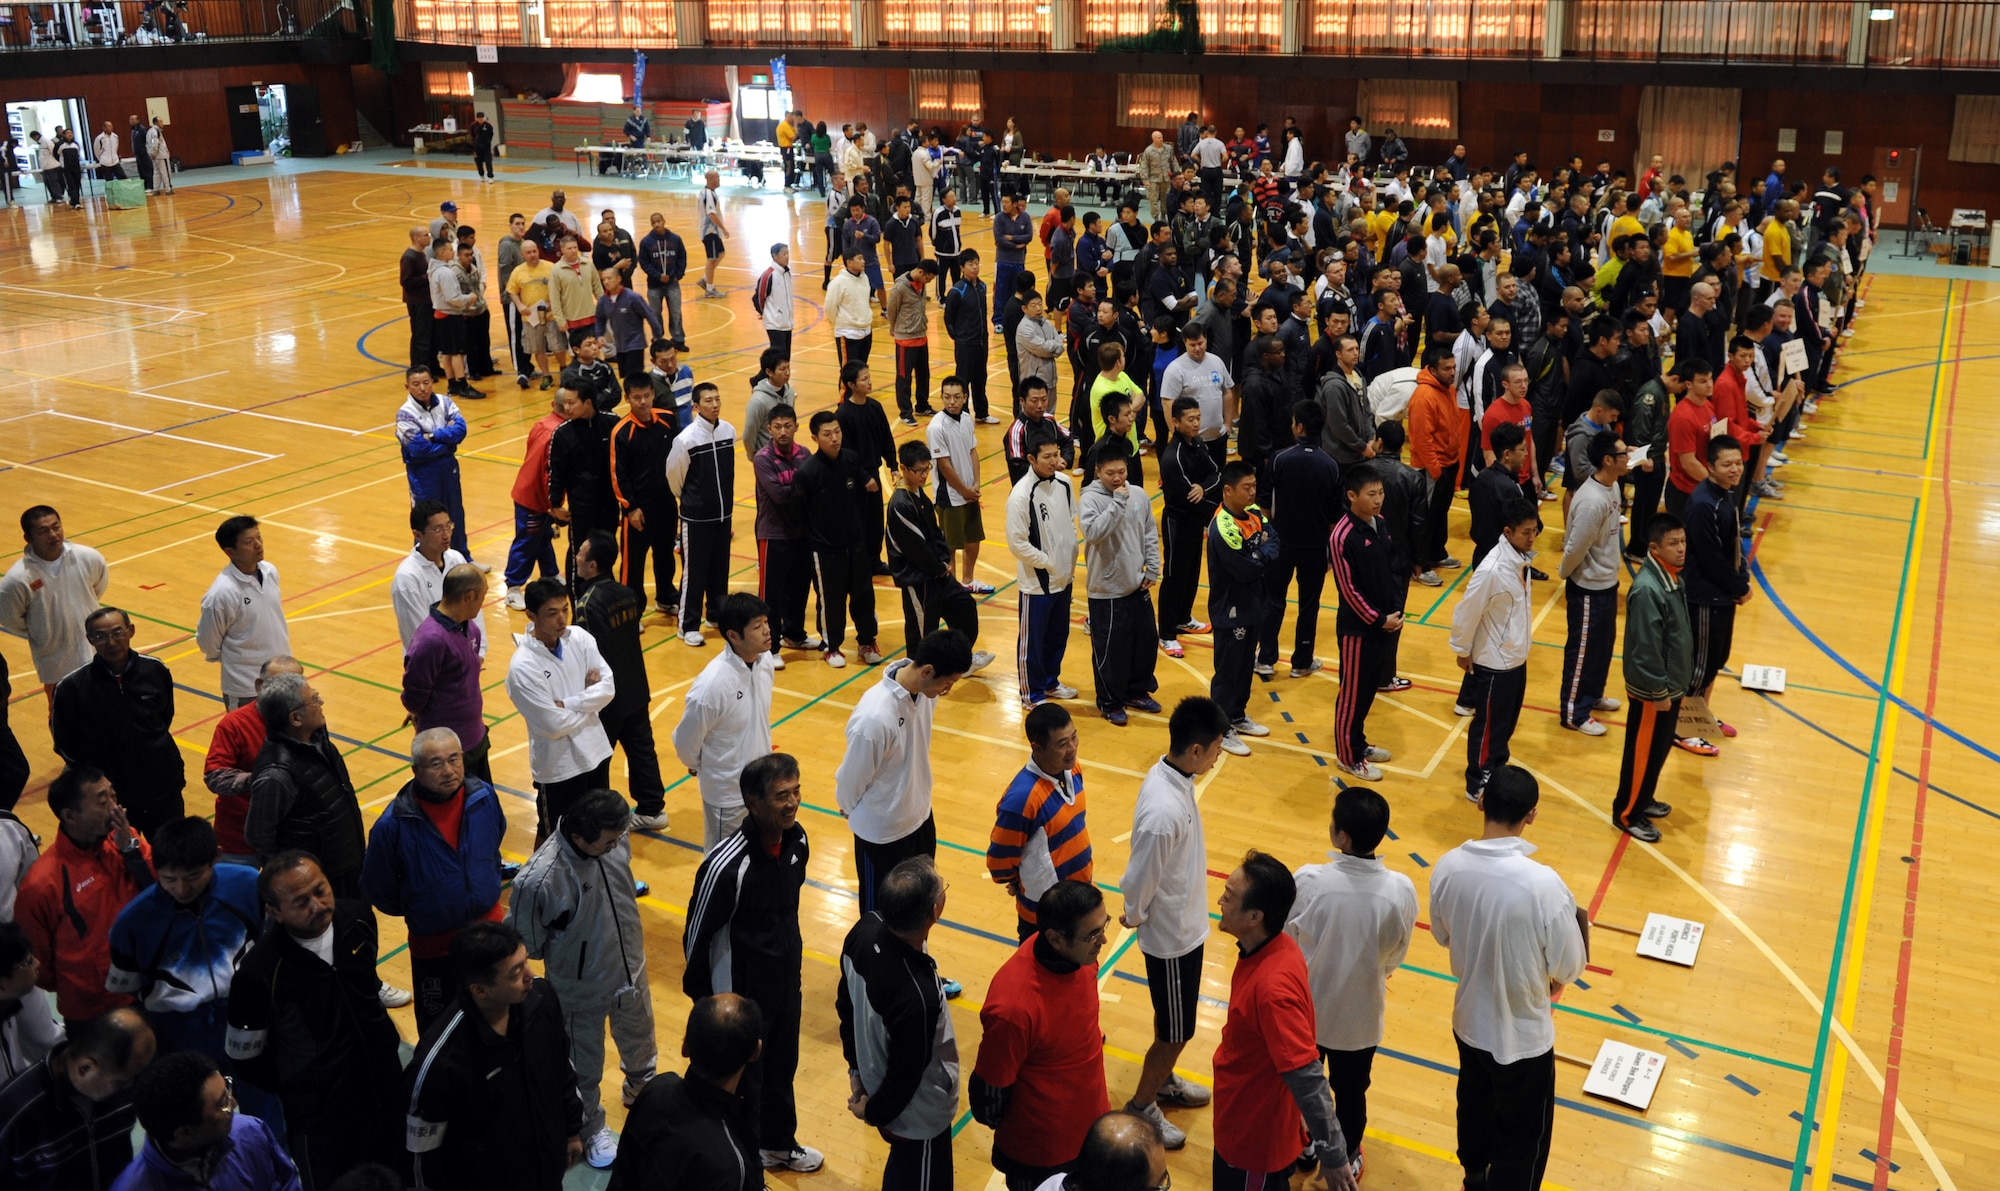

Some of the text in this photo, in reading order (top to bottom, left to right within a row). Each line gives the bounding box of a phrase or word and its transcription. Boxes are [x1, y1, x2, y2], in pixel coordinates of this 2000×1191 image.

[1324, 290, 1334, 299] 12
[424, 978, 444, 1015] FILA
[1608, 1069, 1619, 1081] FORCE
[1620, 1052, 1645, 1095] Queen Bee Stingers
[1643, 1068, 1652, 1080] A-2
